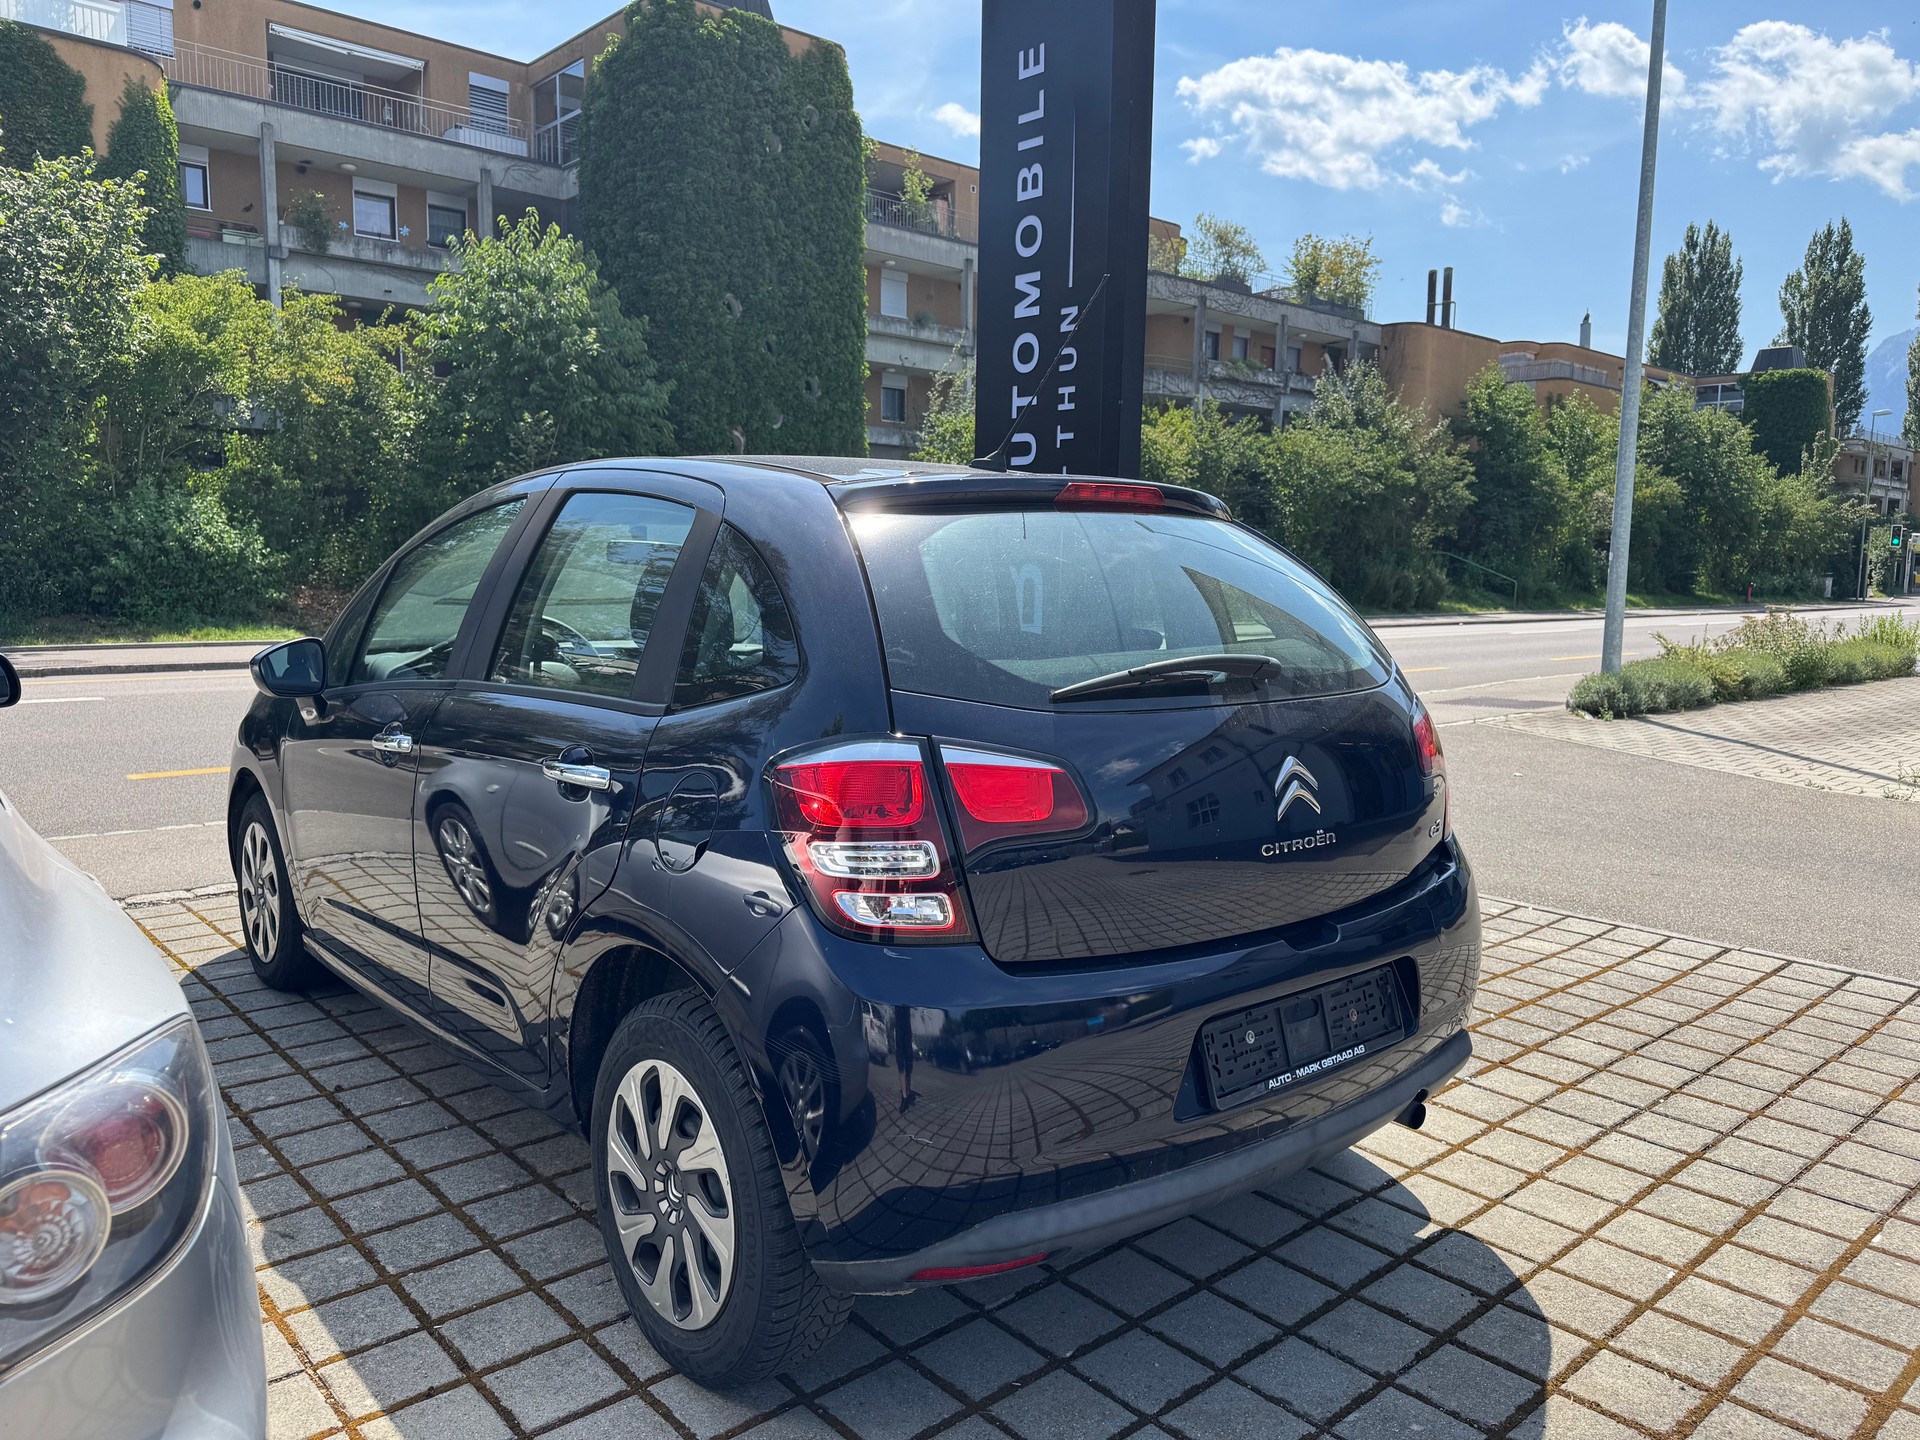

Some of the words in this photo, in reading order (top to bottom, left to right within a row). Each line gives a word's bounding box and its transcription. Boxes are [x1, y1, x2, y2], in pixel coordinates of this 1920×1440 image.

[1011, 42, 1046, 467] UTOMOBILE
[1056, 305, 1079, 449] THUN
[1268, 1073, 1292, 1090] AUTO
[1296, 1061, 1322, 1078] MARK
[1321, 1049, 1353, 1068] GSTAAD
[1353, 1044, 1366, 1056] AG
[735, 1159, 756, 1292] UNIROYAL
